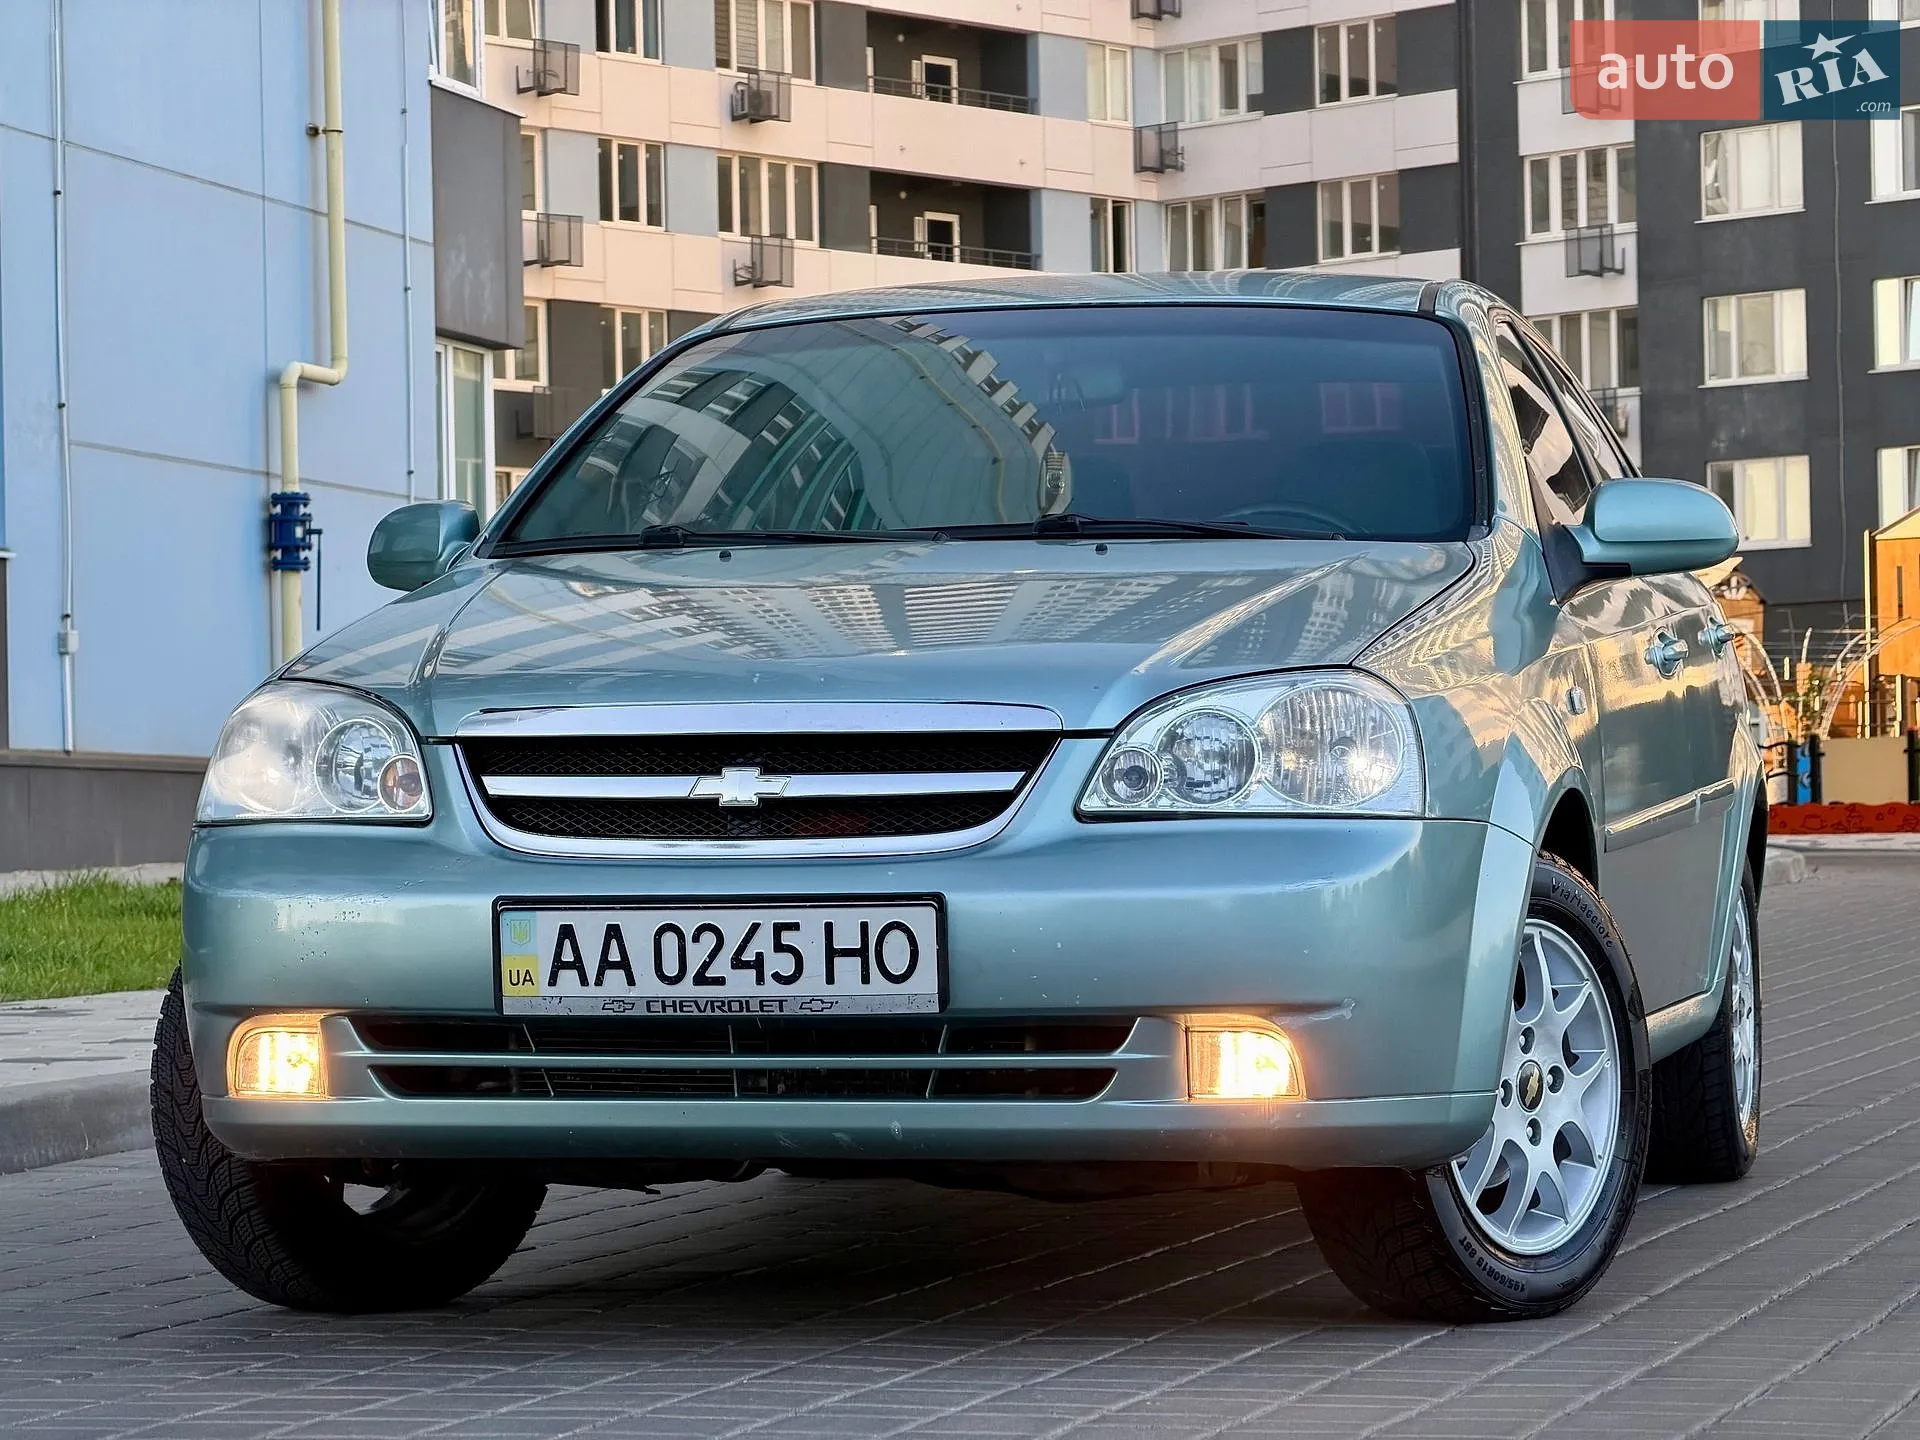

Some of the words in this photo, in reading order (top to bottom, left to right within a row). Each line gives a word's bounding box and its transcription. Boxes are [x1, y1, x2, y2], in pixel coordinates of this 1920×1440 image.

[547, 923, 636, 987] AA
[653, 921, 804, 986] 0245
[824, 920, 919, 985] HO
[508, 969, 535, 987] UA
[645, 999, 788, 1014] CHEVROLET
